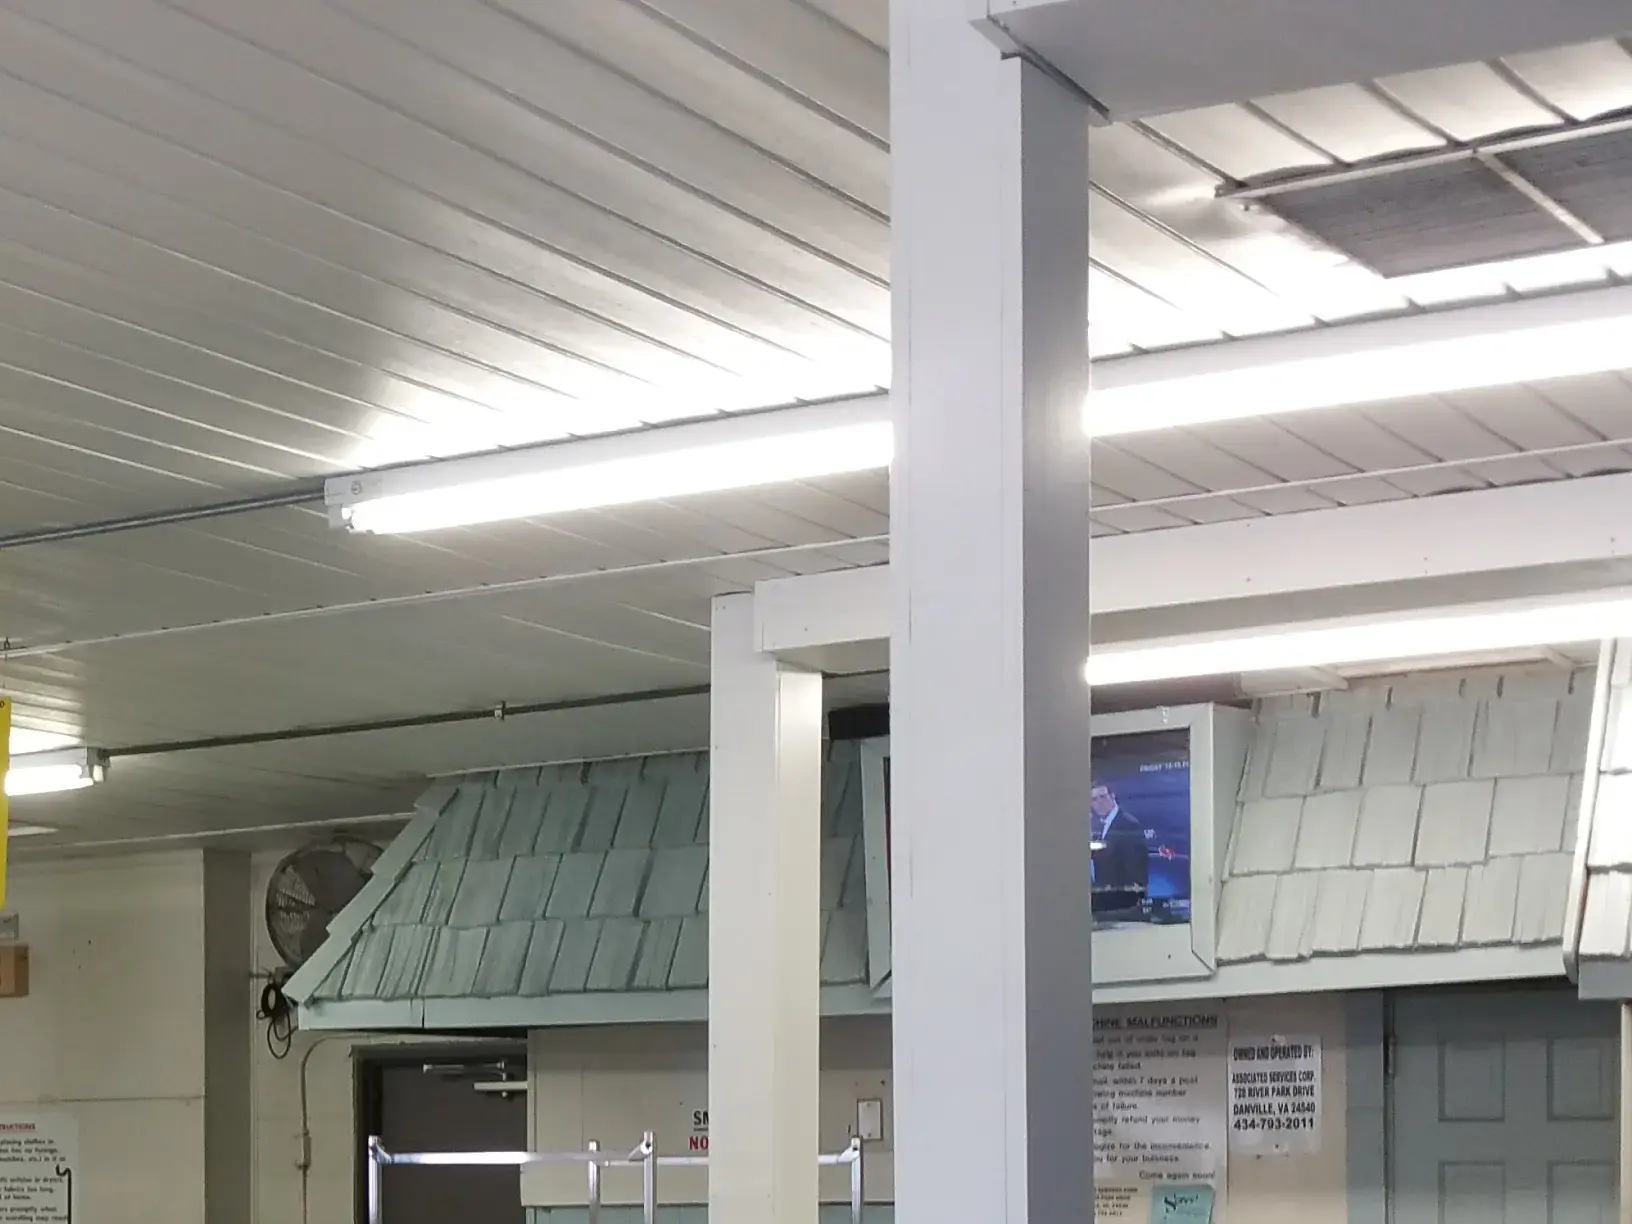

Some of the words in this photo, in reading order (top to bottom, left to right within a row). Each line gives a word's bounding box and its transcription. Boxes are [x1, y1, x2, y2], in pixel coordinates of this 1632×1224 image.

[1256, 1046, 1270, 1060] AND
[1270, 1045, 1302, 1060] OPERATED
[1232, 1072, 1268, 1084] ASSOCIATED
[1269, 1071, 1297, 1083] SERVICES
[1248, 1086, 1270, 1098] RIVER
[1271, 1086, 1290, 1097] PARK
[1292, 1085, 1314, 1097] DRIVE
[1233, 1102, 1276, 1116] DANVILLE,
[1277, 1102, 1289, 1114] VA
